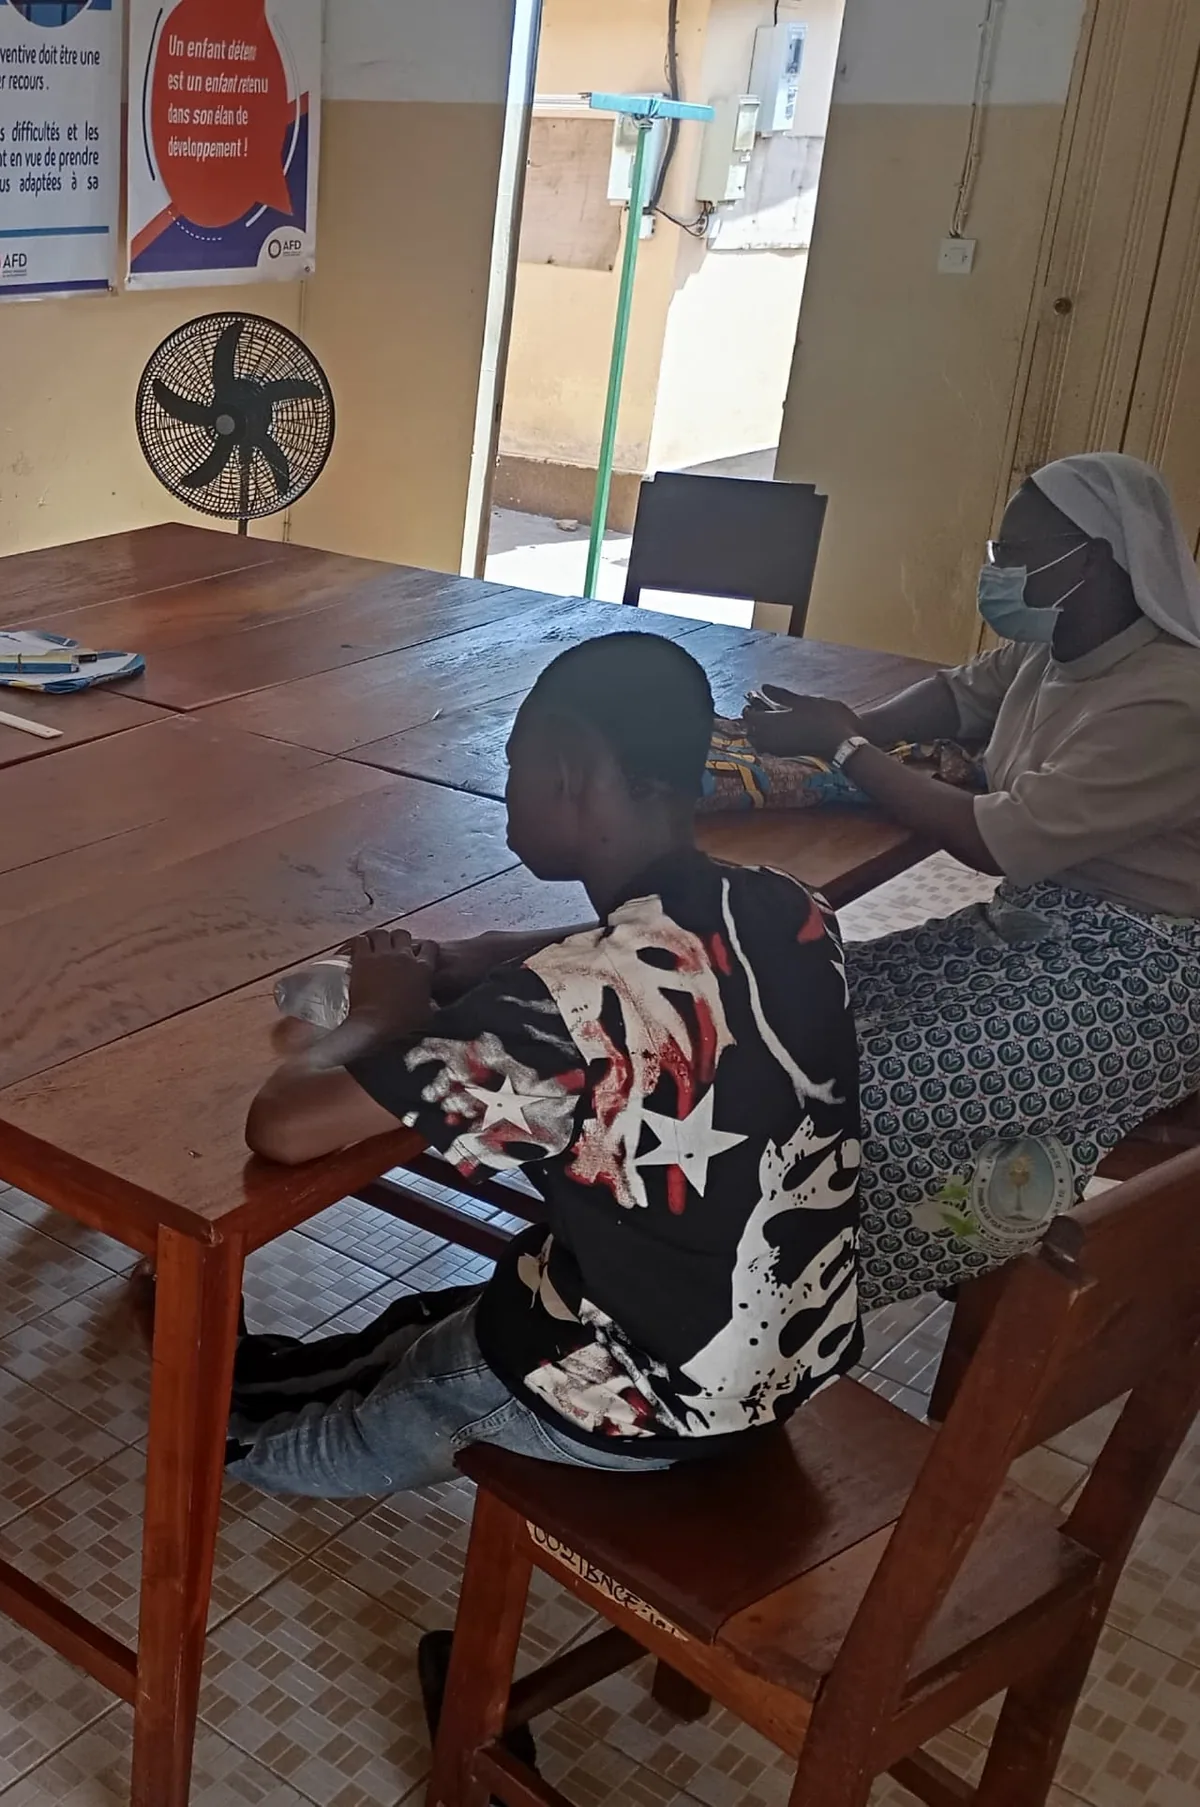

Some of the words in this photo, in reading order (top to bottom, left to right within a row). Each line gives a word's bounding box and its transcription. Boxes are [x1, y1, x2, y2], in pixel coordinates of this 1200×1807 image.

[39, 45, 58, 64] doit
[59, 47, 78, 65] être
[80, 51, 100, 65] une
[169, 34, 184, 56] Un
[187, 38, 225, 60] enfant
[8, 74, 44, 90] recours
[168, 71, 183, 91] est
[187, 75, 202, 92] un
[205, 72, 237, 93] enfant
[168, 103, 189, 124] dans
[192, 109, 215, 126] son
[214, 104, 234, 126] élan
[236, 105, 249, 125] de
[11, 121, 60, 141] difficultés
[67, 124, 78, 141] et
[85, 120, 99, 141] les
[10, 153, 22, 166] en
[24, 153, 42, 166] vue
[44, 147, 56, 166] de
[59, 147, 99, 171] prendre
[168, 137, 242, 162] développement
[19, 172, 62, 197] adaptées
[71, 171, 77, 191] à
[87, 175, 99, 190] sa
[283, 240, 301, 250] AFD
[3, 253, 27, 268] AFD
